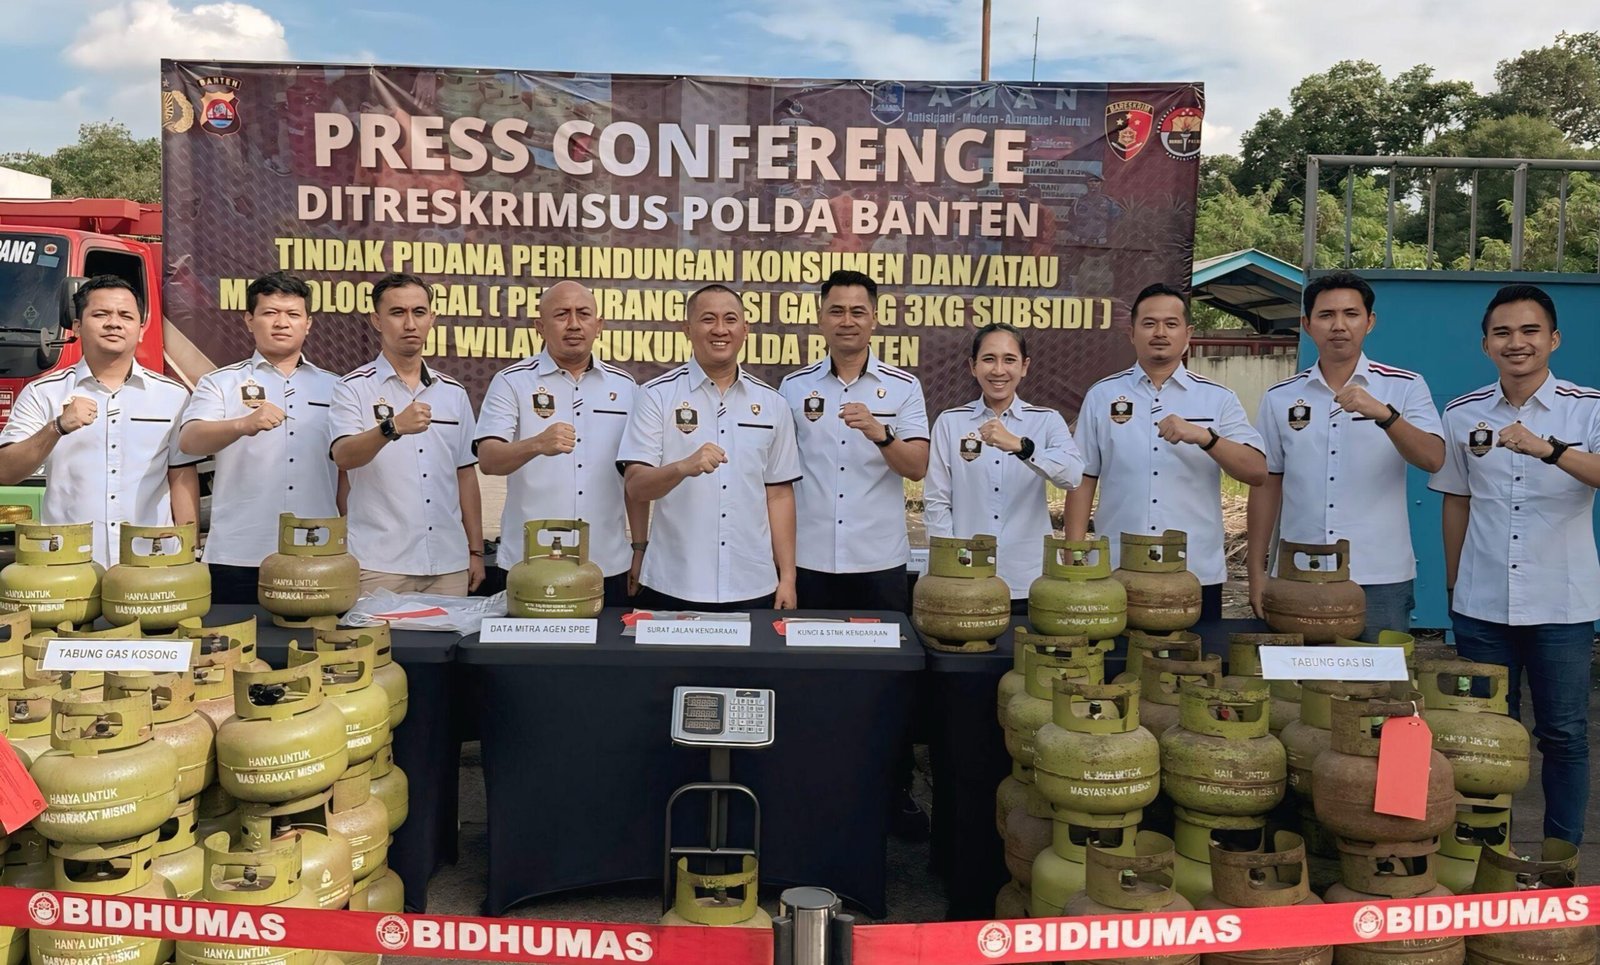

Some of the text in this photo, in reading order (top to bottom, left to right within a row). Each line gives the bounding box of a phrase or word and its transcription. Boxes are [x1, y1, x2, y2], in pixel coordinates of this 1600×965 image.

[199, 76, 238, 88] BANTEN
[1109, 102, 1151, 113] BARESKRIM
[963, 112, 998, 124] Modern
[314, 112, 529, 174] PRESS
[553, 119, 1027, 184] CONFERENCE
[297, 185, 1039, 238] DITRESKRIMSUS POLDA BANTEN
[0, 240, 36, 264] ANG
[275, 238, 1059, 288] TINDAK PIDANA PERLINDUNGAN KONSUMEN DAN/ATAU
[778, 292, 822, 325] GA
[904, 295, 965, 327] 3KG
[972, 296, 1093, 330] SUBSIDI
[421, 326, 447, 357] DI
[592, 330, 692, 362] HUKUM
[807, 333, 920, 367] BTEN
[294, 579, 320, 587] UNTUK
[25, 590, 51, 599] UNTUK
[125, 591, 176, 601] HANYA UNTUK
[115, 604, 161, 615] MASYARAKAT
[490, 625, 591, 633] DATA MITRA AGEN SPBE
[695, 627, 738, 635] KENDARAAN
[59, 648, 178, 660] TABUNG GAS KOSONG
[1290, 657, 1375, 667] TABUNG GAS ISI
[248, 749, 312, 767] HANYA UNTUK
[235, 761, 326, 784] MASYARAKAT MISKIN
[49, 788, 118, 805] HANYA UNTUK
[1070, 786, 1128, 797] MASYARAKAT
[40, 801, 137, 825] MASYARAKAT MISKIN
[63, 896, 287, 942] BIDHUMAS
[1386, 894, 1590, 934] BIDHUMAS
[412, 919, 654, 962] BIDHUMAS
[1014, 914, 1242, 953] BIDHUMAS
[54, 934, 124, 950] HANYA UNTUK
[203, 945, 272, 960] HANYA UNTUK
